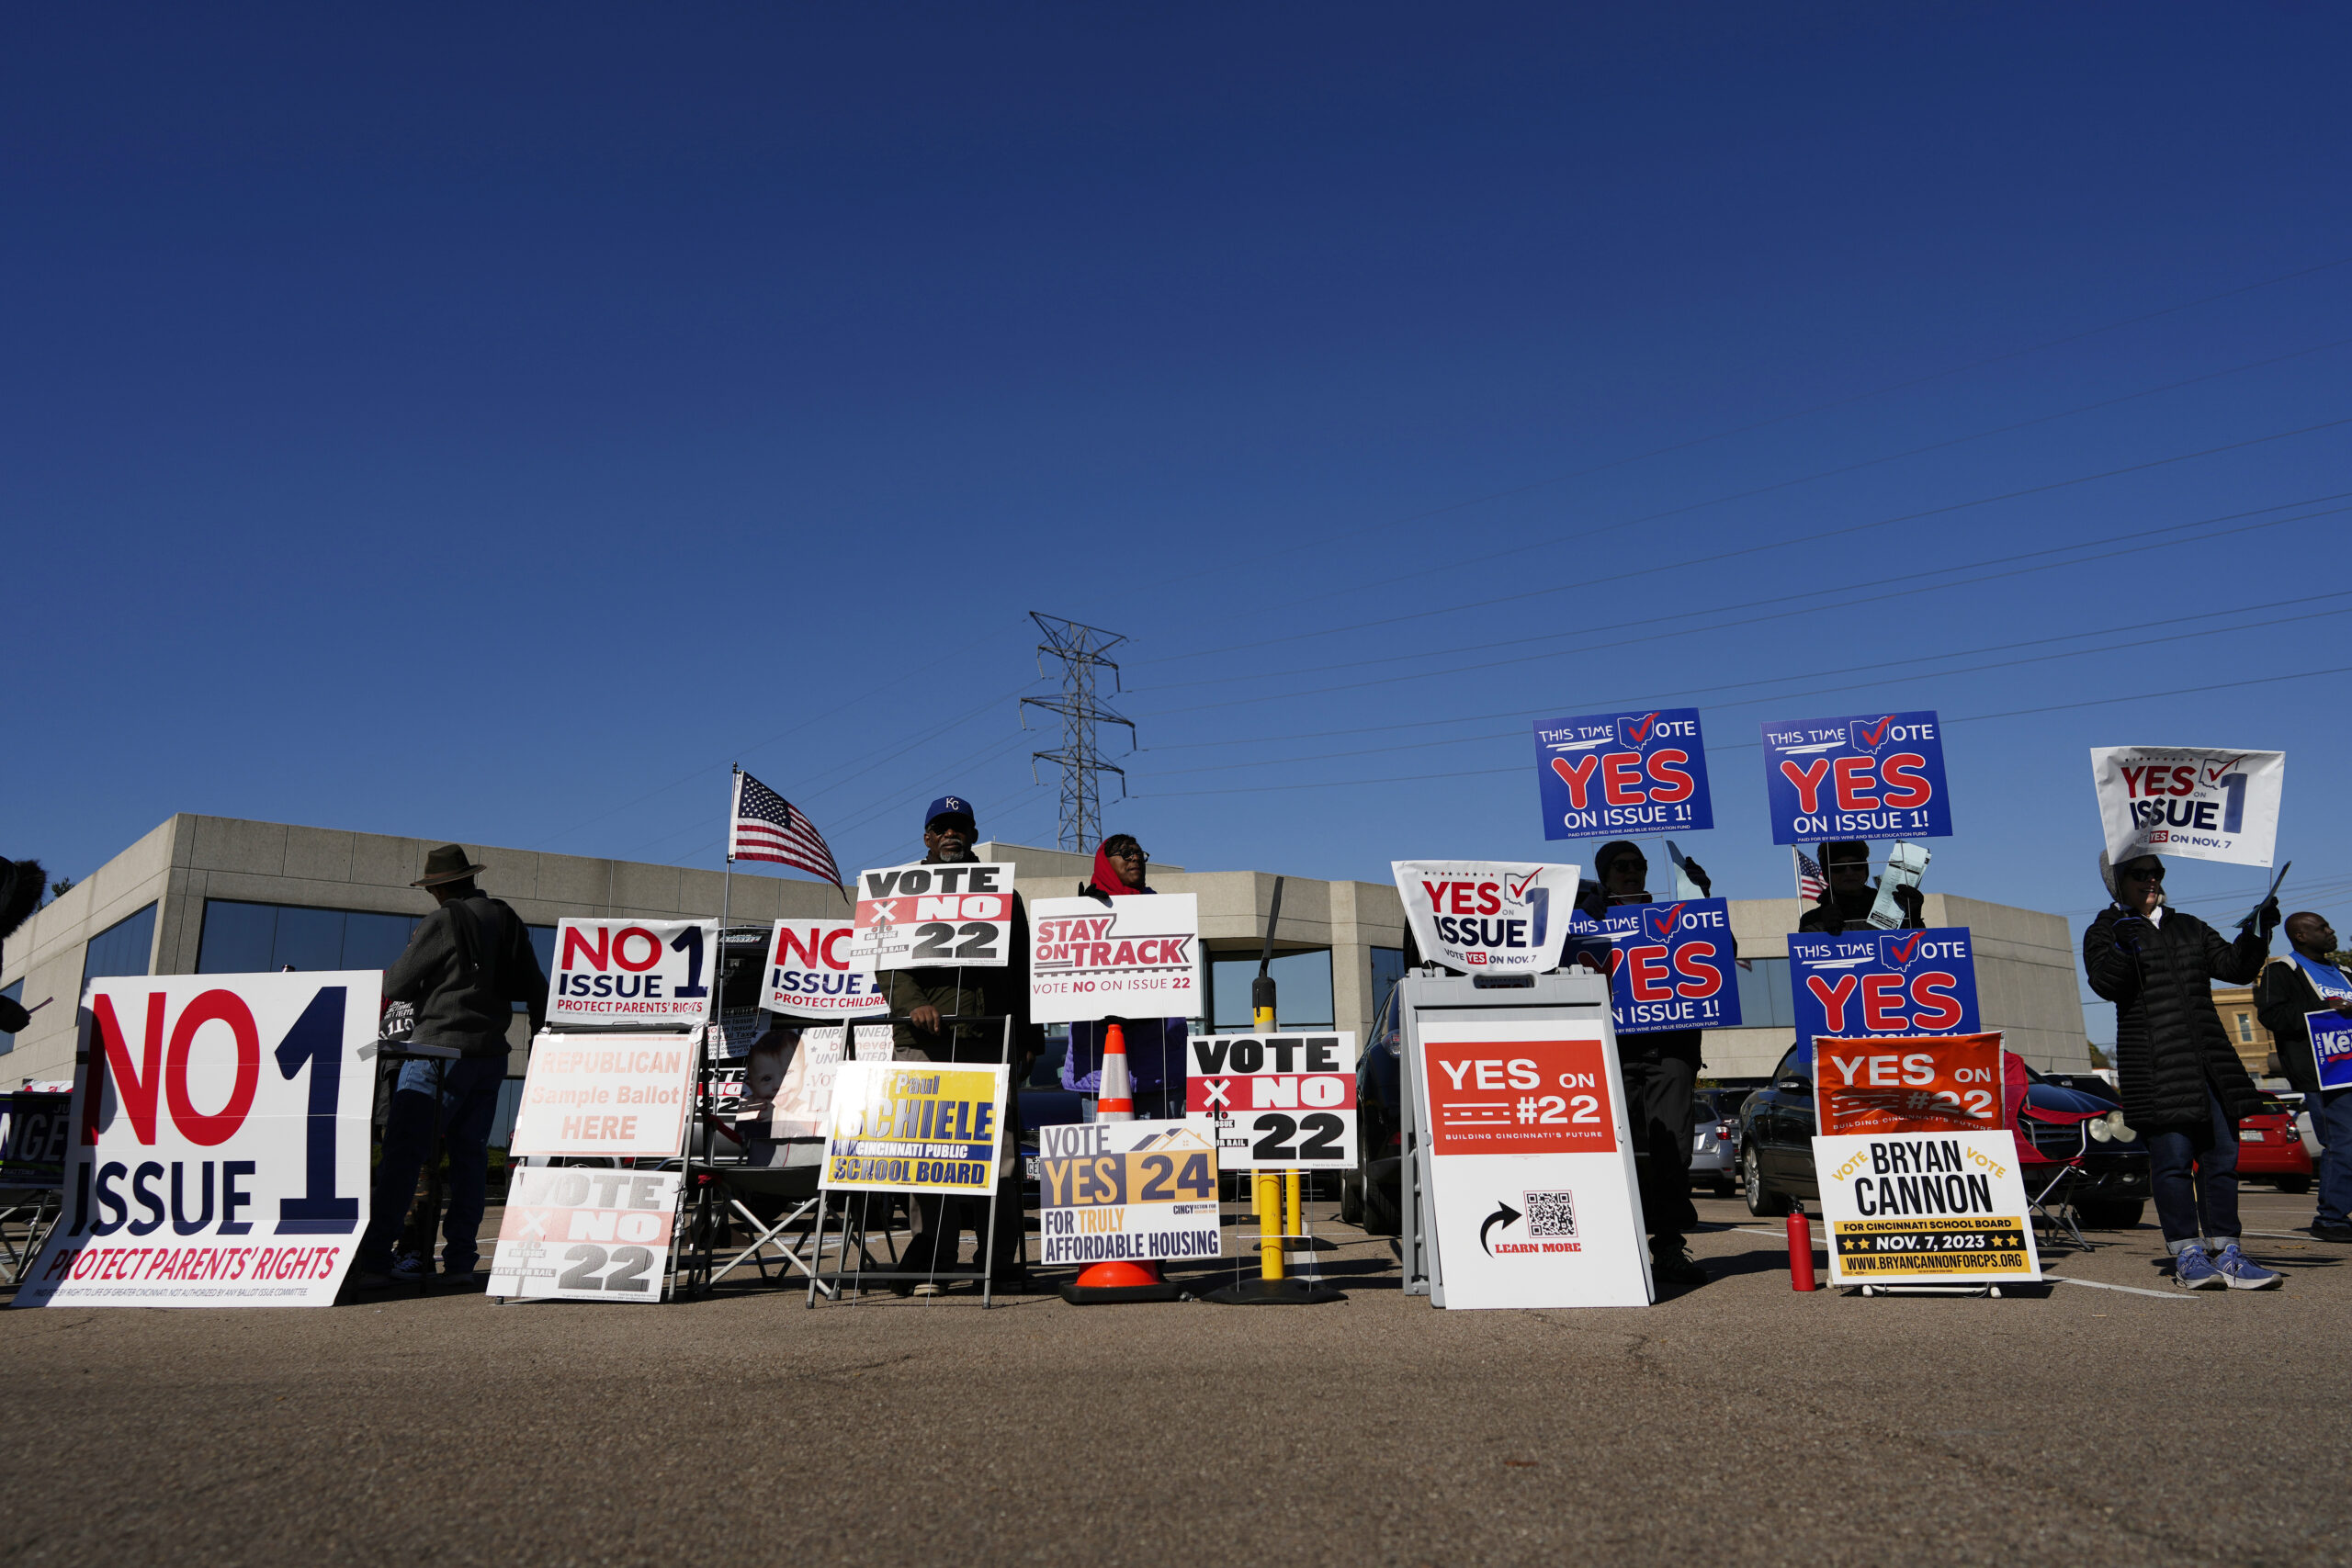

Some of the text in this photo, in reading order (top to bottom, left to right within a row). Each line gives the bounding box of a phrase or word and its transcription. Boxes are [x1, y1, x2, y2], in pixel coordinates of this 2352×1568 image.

[1539, 728, 1574, 742] THIS
[1577, 725, 1614, 739] TIME
[1767, 731, 1804, 745] THIS
[1808, 728, 1847, 742] TIME
[1551, 749, 1695, 809] YES
[1781, 753, 1932, 815] YES
[2120, 766, 2197, 798] YES
[945, 797, 959, 810] KC
[1564, 804, 1692, 829] ON ISSUE 1!
[2130, 773, 2247, 834] ISSUE 1
[1793, 810, 1929, 834] ON ISSUE 1!
[2150, 832, 2232, 849] YES ON NOV. 7
[865, 867, 1000, 898] VOTE
[916, 895, 1002, 921] NO
[1421, 881, 1501, 916] YES
[1037, 919, 1110, 943] STAY
[1432, 887, 1550, 948] ISSUE 1
[1567, 920, 1599, 934] THIS
[1602, 917, 1639, 931] TIME
[911, 921, 999, 959] 22
[1035, 939, 1183, 967] ON TRACK
[1793, 944, 1832, 958] THIS
[1836, 943, 1875, 957] TIME
[561, 926, 708, 998] NO 1
[1444, 947, 1537, 964] VOTE YES ON NOV. 7
[559, 973, 662, 998] ISSUE
[772, 968, 864, 995] ISSUE
[1577, 942, 1723, 1002] YES
[1033, 977, 1191, 995] VOTE NO ON ISSUE 22
[557, 999, 613, 1012] PROTECT
[615, 1001, 670, 1013] PARENTS'
[775, 992, 836, 1008] PROTECT
[838, 997, 885, 1007] CHILDRE
[1631, 999, 1720, 1023] ISSUE 1!
[1806, 971, 1962, 1032] YES
[1193, 1037, 1339, 1074] VOTE
[2322, 1031, 2352, 1055] Ke
[541, 1051, 681, 1073] REPUBLICAN
[1438, 1058, 1596, 1090] YES ON
[1830, 1054, 1991, 1086] YES ON
[531, 1086, 680, 1108] Sample Ballot
[896, 1074, 940, 1095] Paul
[1252, 1076, 1345, 1108] NO
[80, 986, 358, 1235] NO 1
[1516, 1095, 1600, 1124] #22
[1905, 1089, 1993, 1119] #22
[561, 1115, 638, 1139] HERE
[1215, 1120, 1234, 1128] SSUE
[1252, 1112, 1345, 1160] 22
[1496, 1132, 1562, 1140] CINCINNATI'S
[1833, 1119, 1879, 1130] BUILDING
[856, 1142, 968, 1158] CINCINNATI PUBLIC
[1045, 1125, 1112, 1157] VOTE
[833, 1158, 985, 1185] SCHOOL BOARD
[1831, 1140, 2007, 1181] VOTE BRYAN VOTE
[1044, 1153, 1216, 1205] YES 24
[67, 1160, 255, 1236] ISSUE
[1854, 1174, 1994, 1216] CANNON
[1046, 1208, 1125, 1235] FOR TRULY
[1173, 1204, 1193, 1214] CINCY
[567, 1211, 662, 1243] NO
[1843, 1219, 2011, 1232] FOR CINCINNATI SCHOOL BOARD
[1046, 1230, 1218, 1262] AFFORDABLE HOUSING
[1495, 1243, 1582, 1254] LEARN MORE
[1876, 1235, 1985, 1251] NOV. 7, 2023
[42, 1247, 340, 1280] PROTECT PARENTS' RIGHTS
[558, 1244, 655, 1292] 22
[1846, 1253, 2022, 1270] WWW.BRYANCANNONFORCPS.ORG
